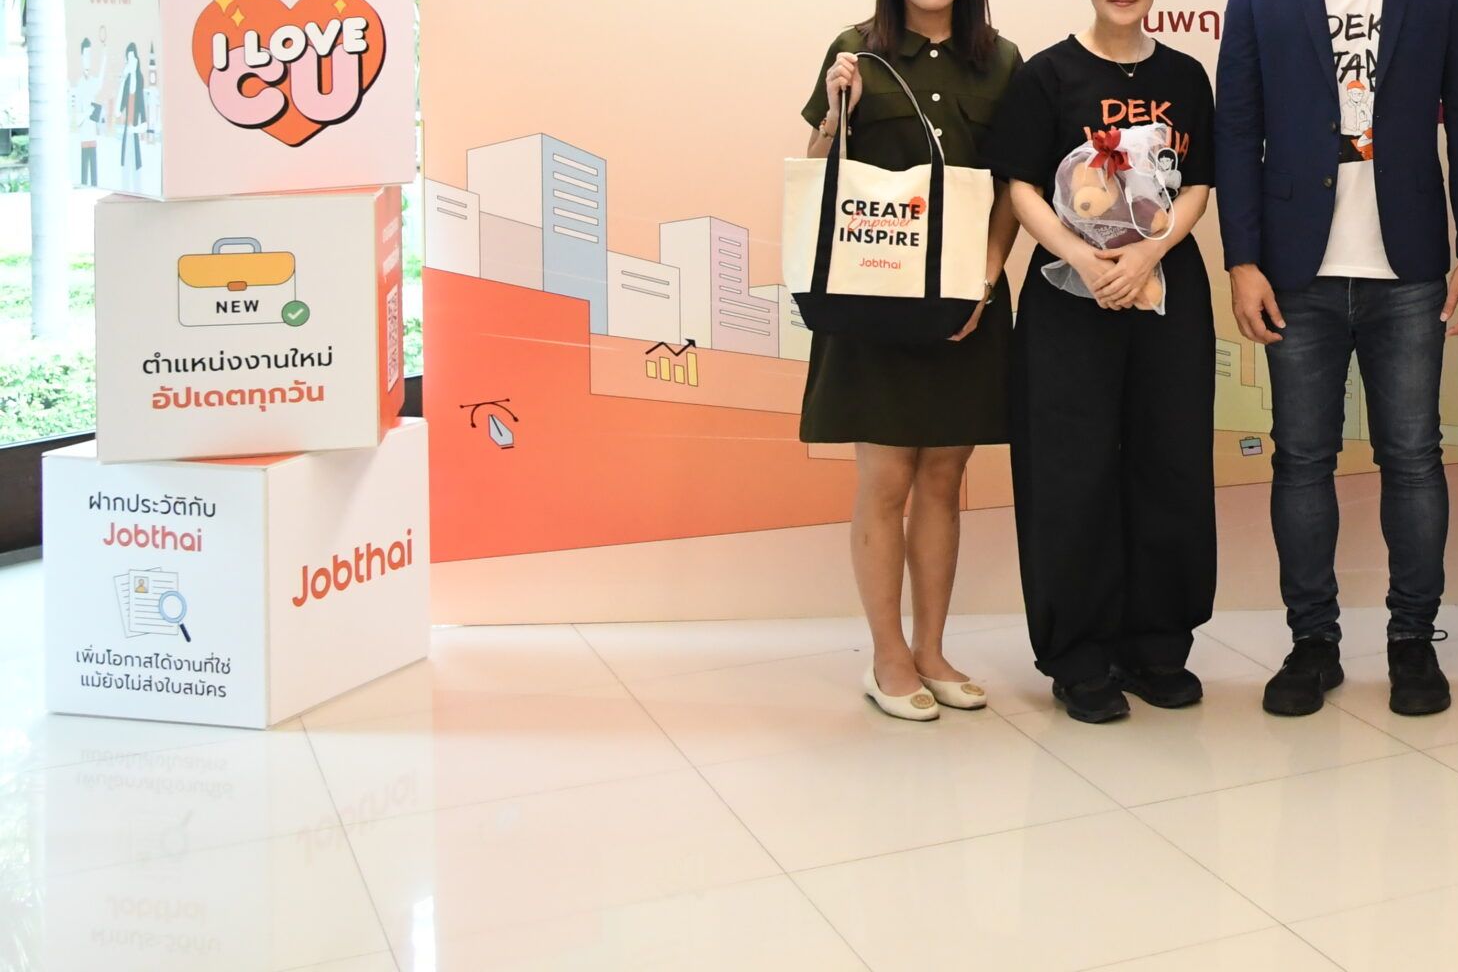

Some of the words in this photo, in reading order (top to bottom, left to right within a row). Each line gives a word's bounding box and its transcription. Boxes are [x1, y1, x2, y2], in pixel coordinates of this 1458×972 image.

[212, 32, 229, 71] I
[244, 17, 369, 69] LOVE
[208, 42, 363, 129] CU
[1101, 98, 1174, 126] DEK
[841, 199, 921, 220] CREATE
[847, 212, 912, 233] Empower
[859, 257, 902, 270] Jobthai
[215, 299, 260, 314] NEW
[142, 345, 333, 375] ตำแหน่งงานใหม่
[152, 379, 325, 412] อัปเดตทุกวัน
[89, 491, 216, 518] ฝากประวัติกับ
[103, 522, 203, 553] Jobthai
[291, 528, 413, 608] Jobthai
[76, 644, 231, 675] เพิ่มโอกาสได้งานที่ใช่
[80, 671, 227, 698] แม้ยังไม่ส่งใบสมัคร
